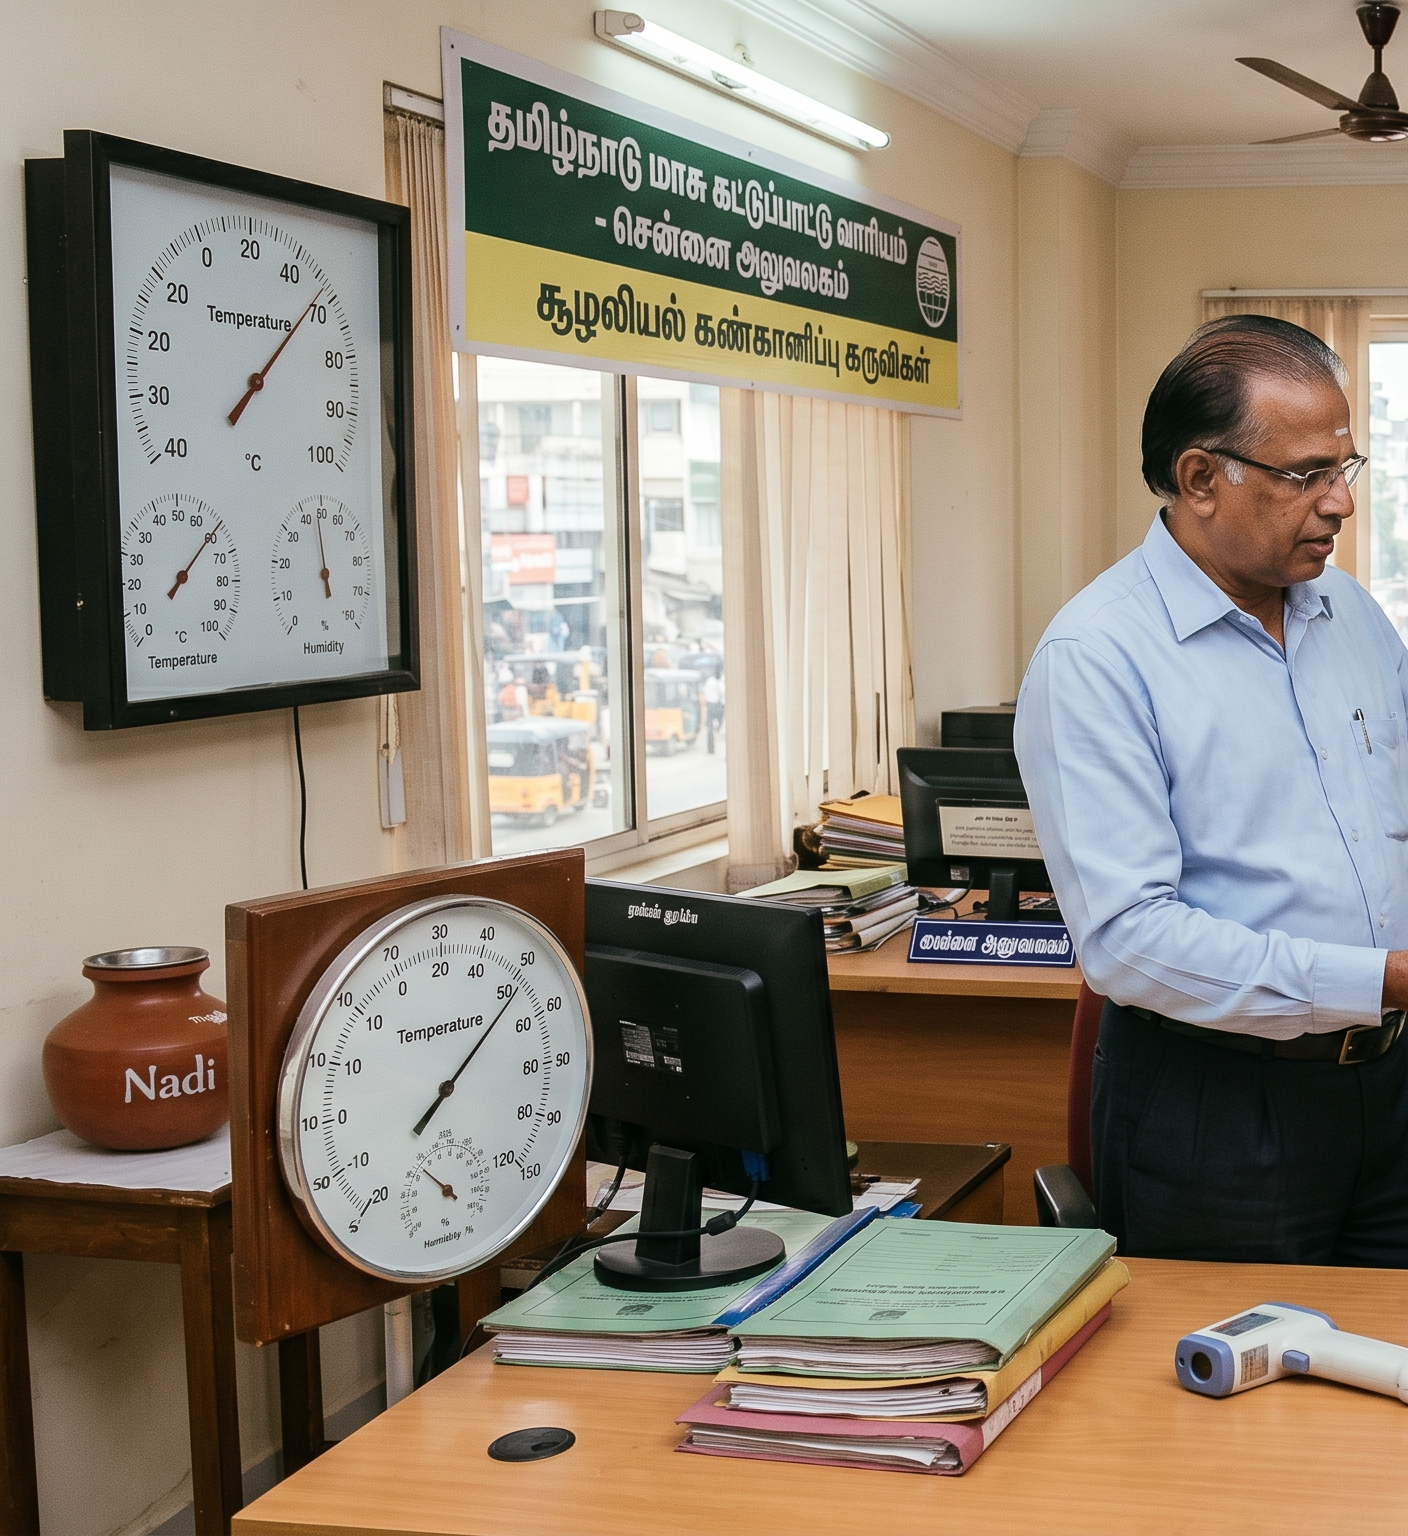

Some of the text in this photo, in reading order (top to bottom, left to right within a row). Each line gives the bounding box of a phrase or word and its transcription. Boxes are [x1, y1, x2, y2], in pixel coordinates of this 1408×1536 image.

[487, 101, 908, 266] தமிழ்நாடு மாசு கட்டுப்பாட்டு வாரியம்
[240, 238, 260, 260] 20
[613, 205, 731, 271] சென்னை
[736, 240, 850, 300] அலுவலகம்
[201, 247, 212, 268] 0
[279, 263, 300, 284] 40
[166, 282, 189, 305] 20
[206, 304, 292, 332] Temperature
[309, 303, 327, 325] 70
[147, 330, 170, 352] 20
[536, 282, 931, 385] சூழலியல் கண்காணிப்பு கருவிகள்
[325, 350, 343, 370] 80
[148, 384, 170, 406] 30
[326, 400, 345, 420] 90
[165, 437, 188, 458] 40
[307, 445, 335, 464] 100
[244, 452, 262, 472] °C
[152, 514, 167, 526] 40
[171, 510, 185, 522] 50
[189, 515, 203, 527] 60
[300, 514, 312, 525] 40
[332, 514, 344, 526] 60
[138, 531, 153, 544] 30
[287, 531, 299, 543] 20
[344, 530, 355, 542] 70
[129, 553, 144, 566] 30
[213, 552, 227, 565] 70
[279, 558, 291, 569] 20
[352, 556, 363, 567] 80
[127, 578, 142, 590] 20
[216, 575, 229, 587] 80
[281, 590, 293, 601] 10
[352, 585, 363, 597] 70
[133, 603, 147, 615] 10
[213, 599, 227, 611] 90
[200, 620, 219, 632] 100
[292, 615, 298, 626] 0
[145, 623, 153, 636] 0
[303, 640, 345, 655] Humidity
[147, 651, 218, 671] Temperature
[431, 924, 448, 940] 30
[479, 926, 495, 941] 40
[382, 945, 399, 962] 70
[520, 951, 535, 967] 50
[431, 961, 450, 978] 20
[467, 963, 485, 979] 40
[398, 980, 408, 996] 0
[496, 983, 513, 1000] 50
[336, 991, 353, 1008] 10
[546, 996, 562, 1012] 60
[366, 1014, 383, 1031] 10
[396, 1014, 484, 1045] Temperature
[515, 1016, 532, 1033] 60
[309, 1052, 326, 1068] 10
[344, 1058, 362, 1076] 10
[124, 1053, 216, 1104] Nadi
[338, 1109, 347, 1125] 0
[517, 1103, 533, 1121] 80
[546, 1110, 561, 1126] 90
[301, 1115, 318, 1132] 10
[347, 1151, 370, 1169] -10
[492, 1150, 515, 1169] 120
[520, 1163, 541, 1181] 150
[312, 1175, 331, 1191] 50
[371, 1186, 389, 1205] 20
